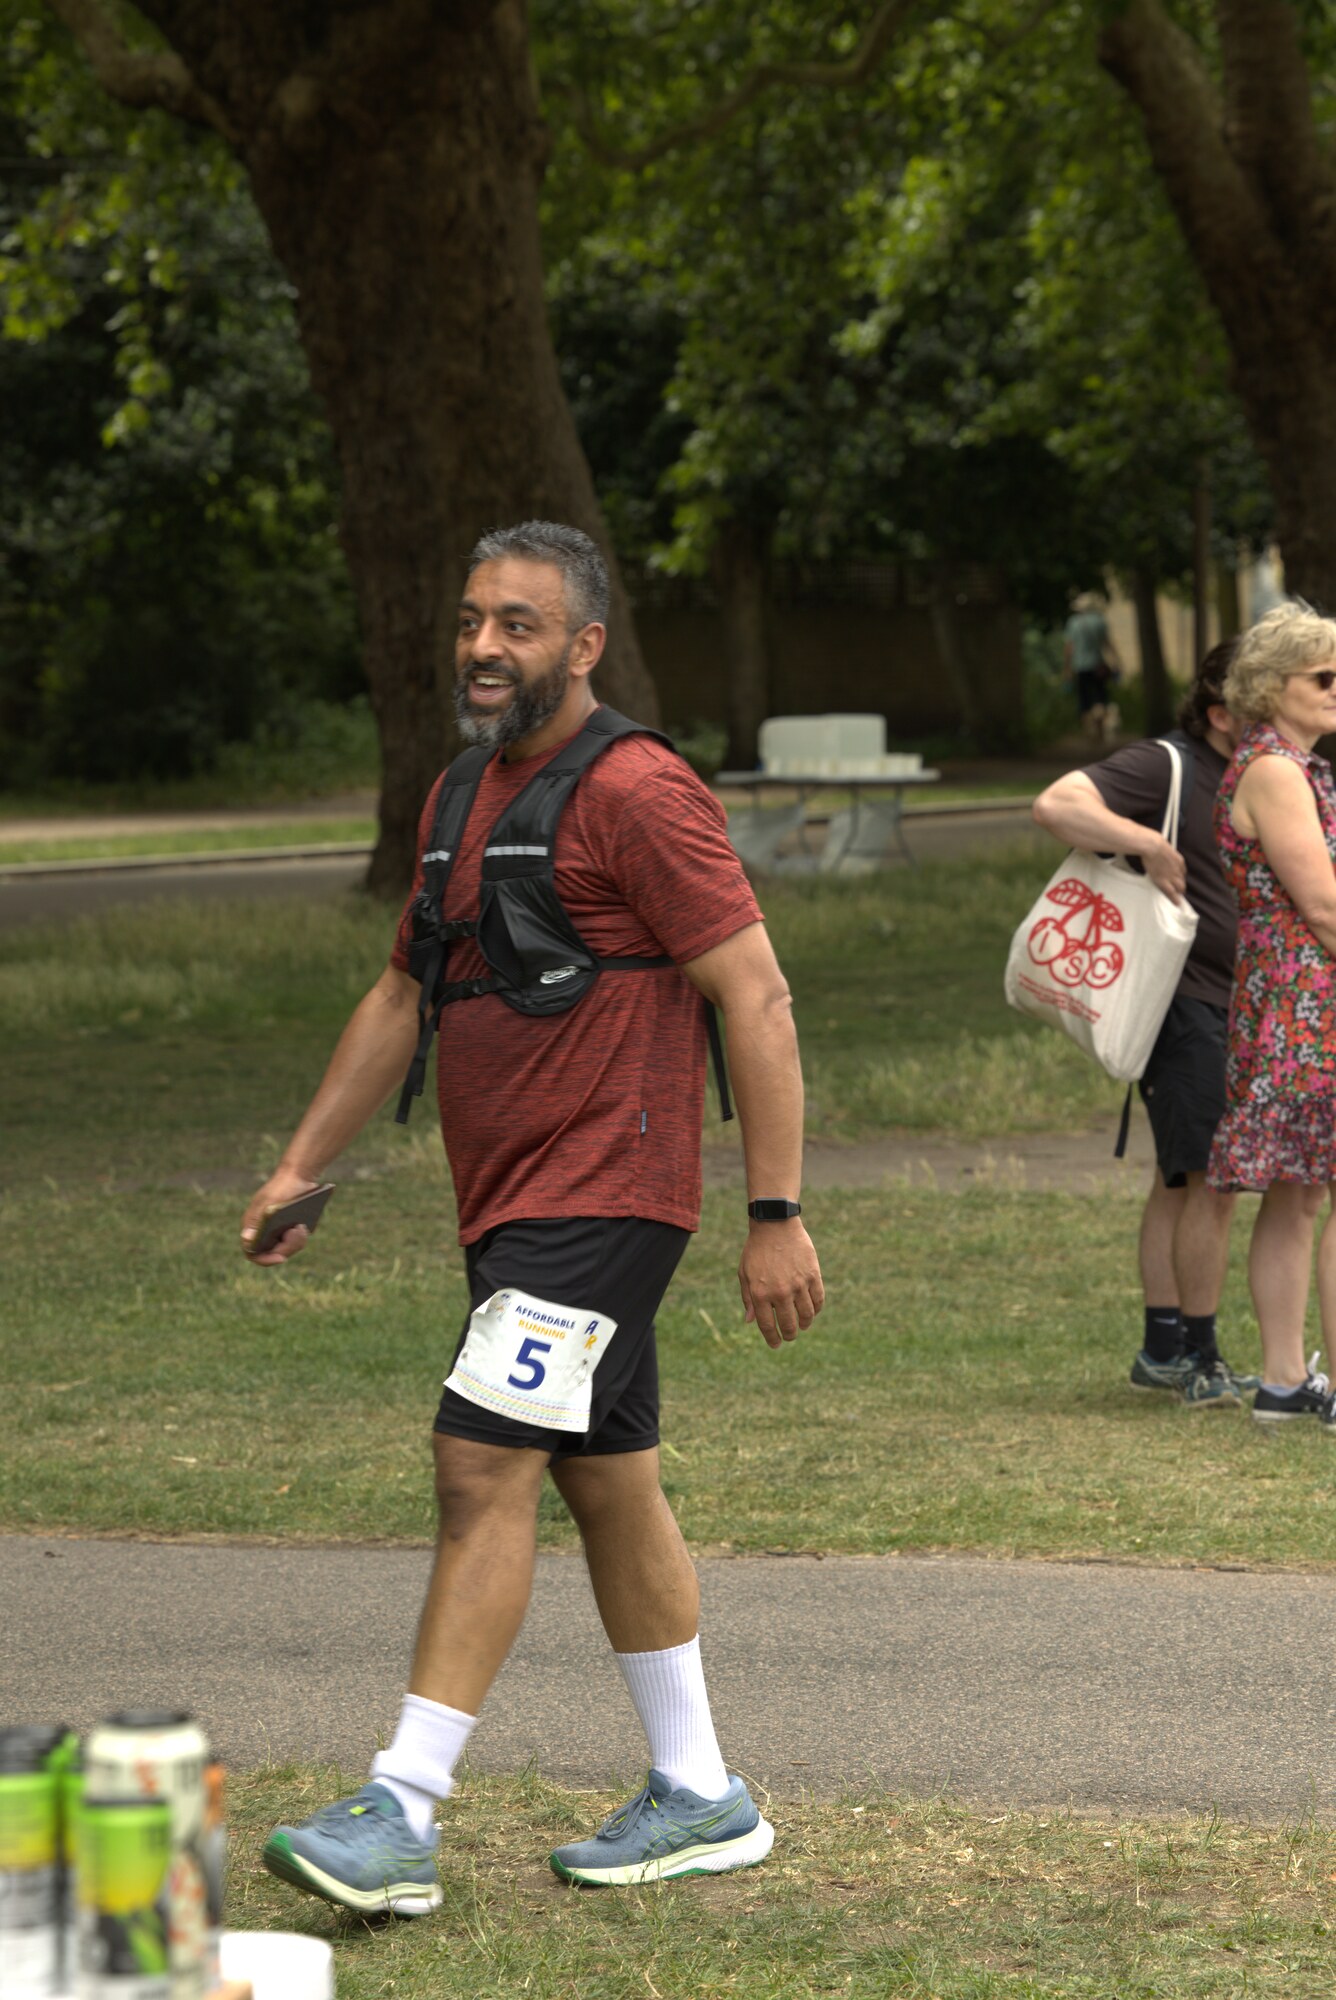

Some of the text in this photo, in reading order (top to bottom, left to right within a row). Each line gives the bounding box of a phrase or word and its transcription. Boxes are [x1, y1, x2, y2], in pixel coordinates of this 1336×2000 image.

[515, 1304, 577, 1330] AFFORDABLE
[517, 1319, 566, 1341] RUNNING
[506, 1337, 552, 1391] 5
